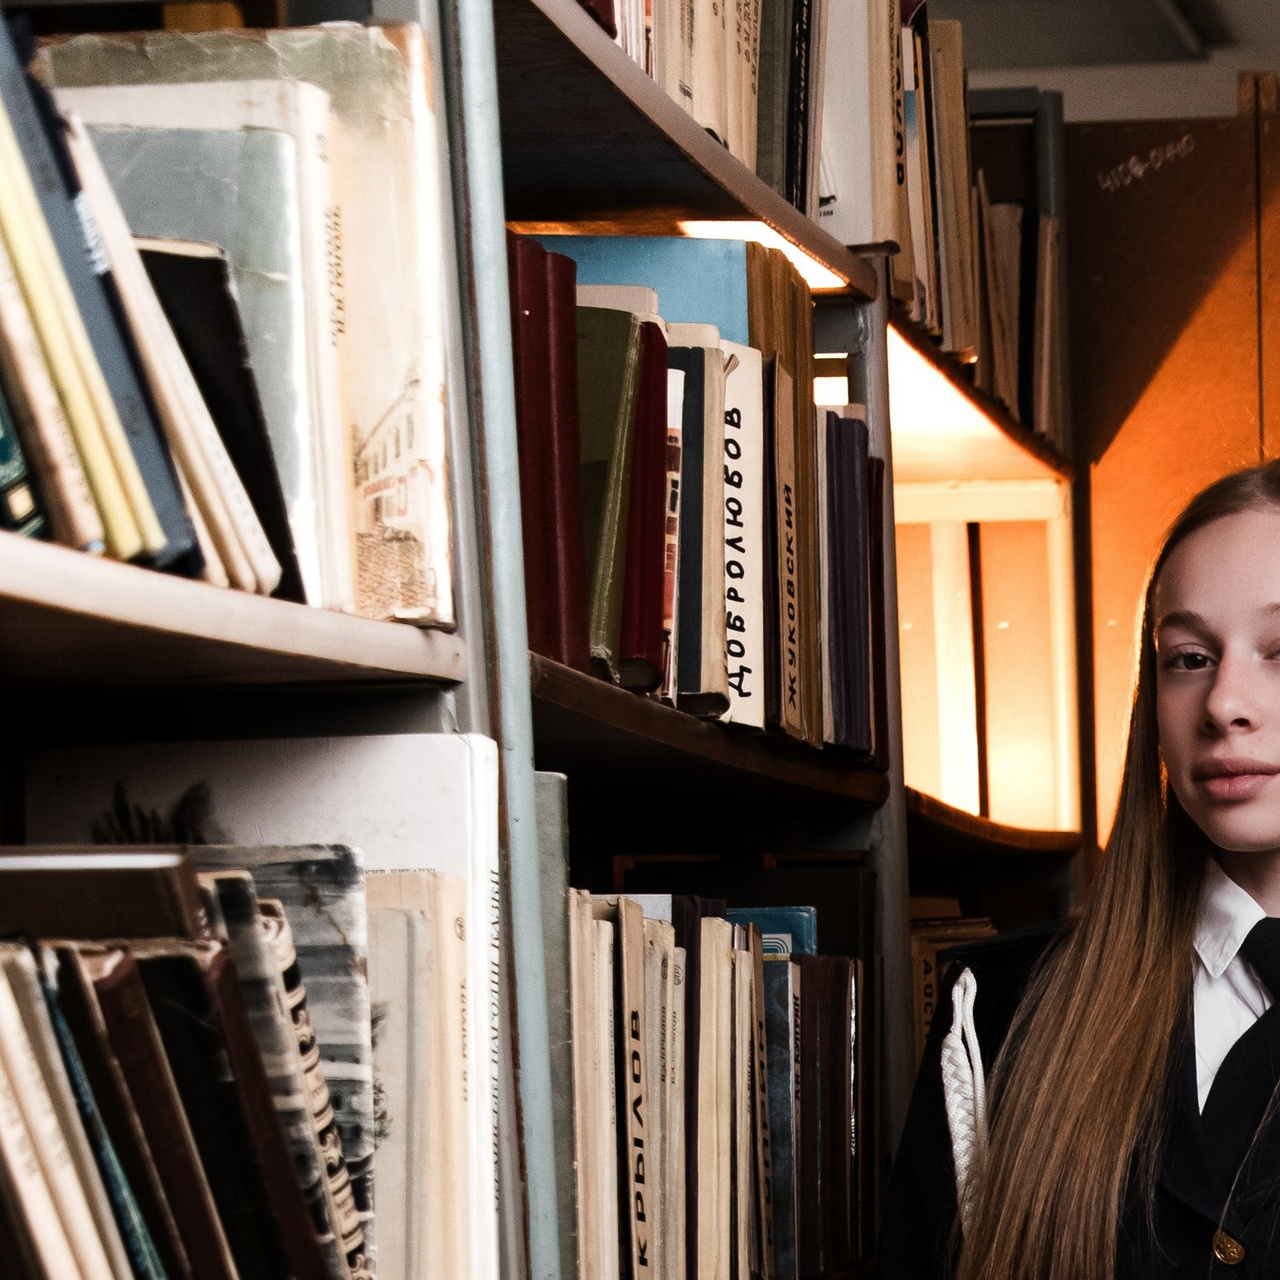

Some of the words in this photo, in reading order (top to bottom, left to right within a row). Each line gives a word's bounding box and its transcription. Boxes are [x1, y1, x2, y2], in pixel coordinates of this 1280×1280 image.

[723, 407, 752, 698] ДОБРОЛЮБОВ
[783, 484, 797, 711] ЖУКОВСКИЙ
[630, 1009, 649, 1268] КРЫЛОВ
